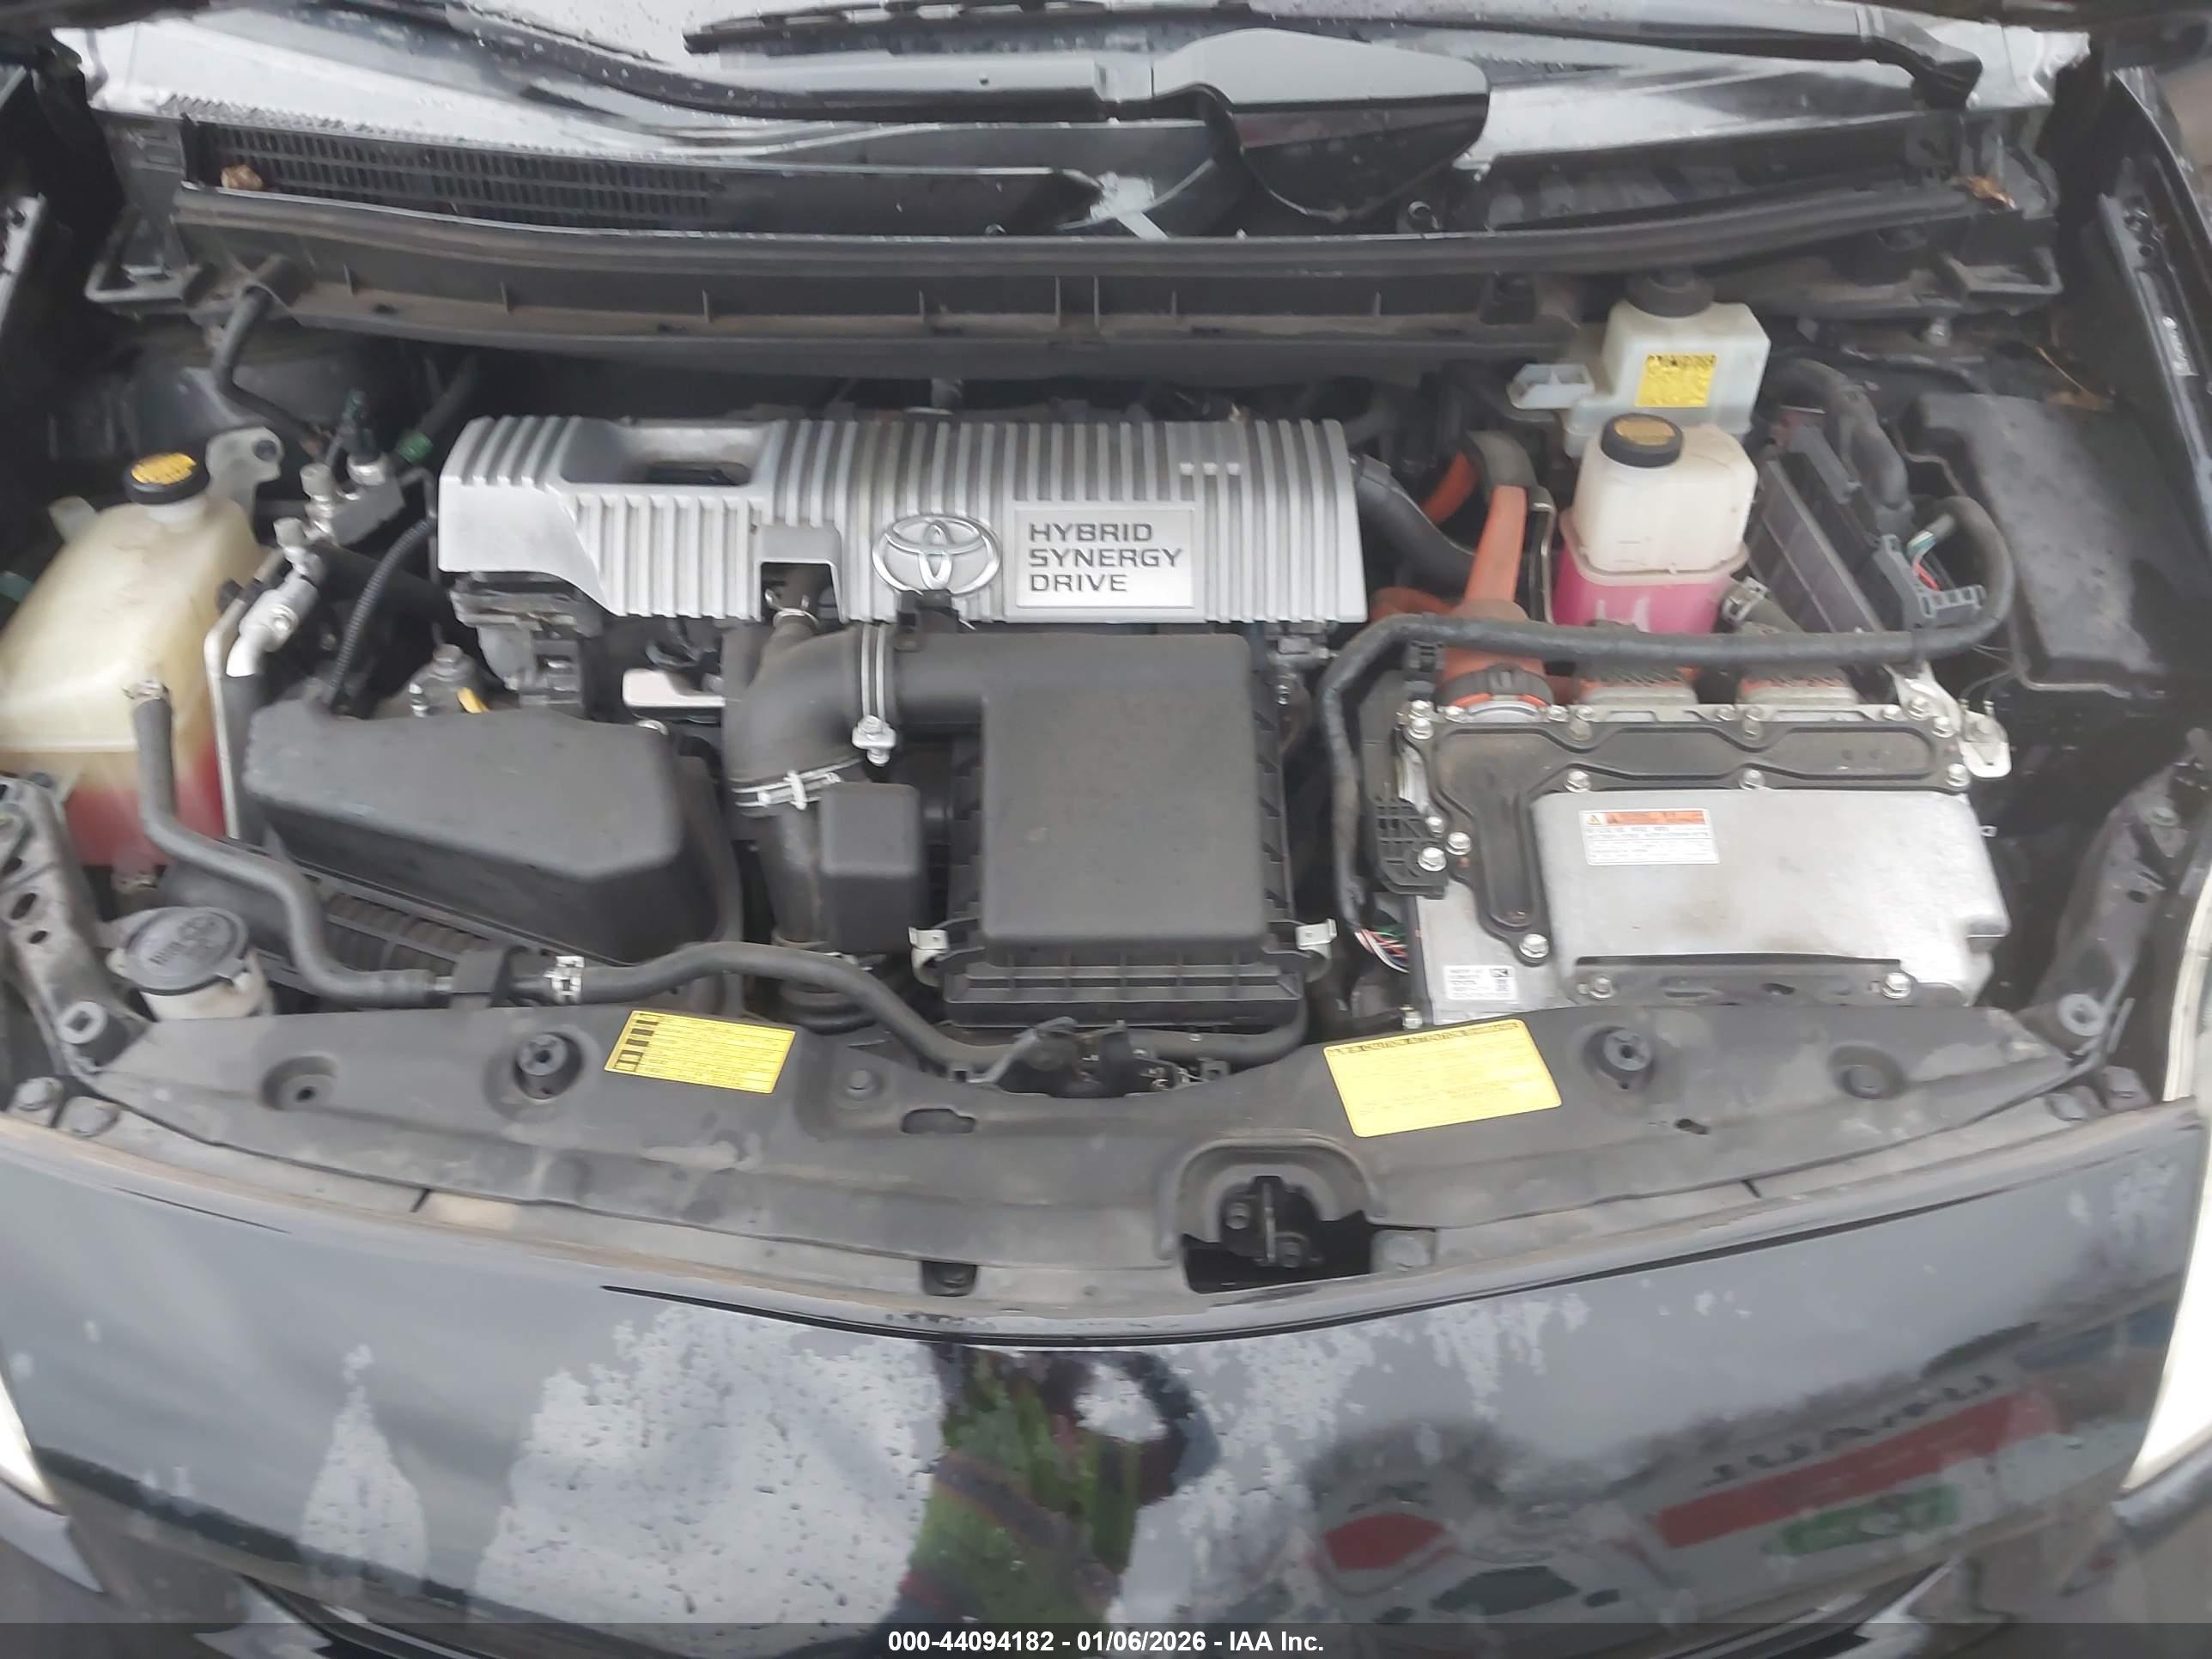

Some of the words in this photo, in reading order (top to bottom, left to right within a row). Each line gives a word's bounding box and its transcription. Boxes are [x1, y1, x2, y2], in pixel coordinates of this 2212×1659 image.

[1029, 522, 1152, 542] HYBRID
[1029, 548, 1182, 568] SYNERGY
[1030, 574, 1127, 592] DRIVE
